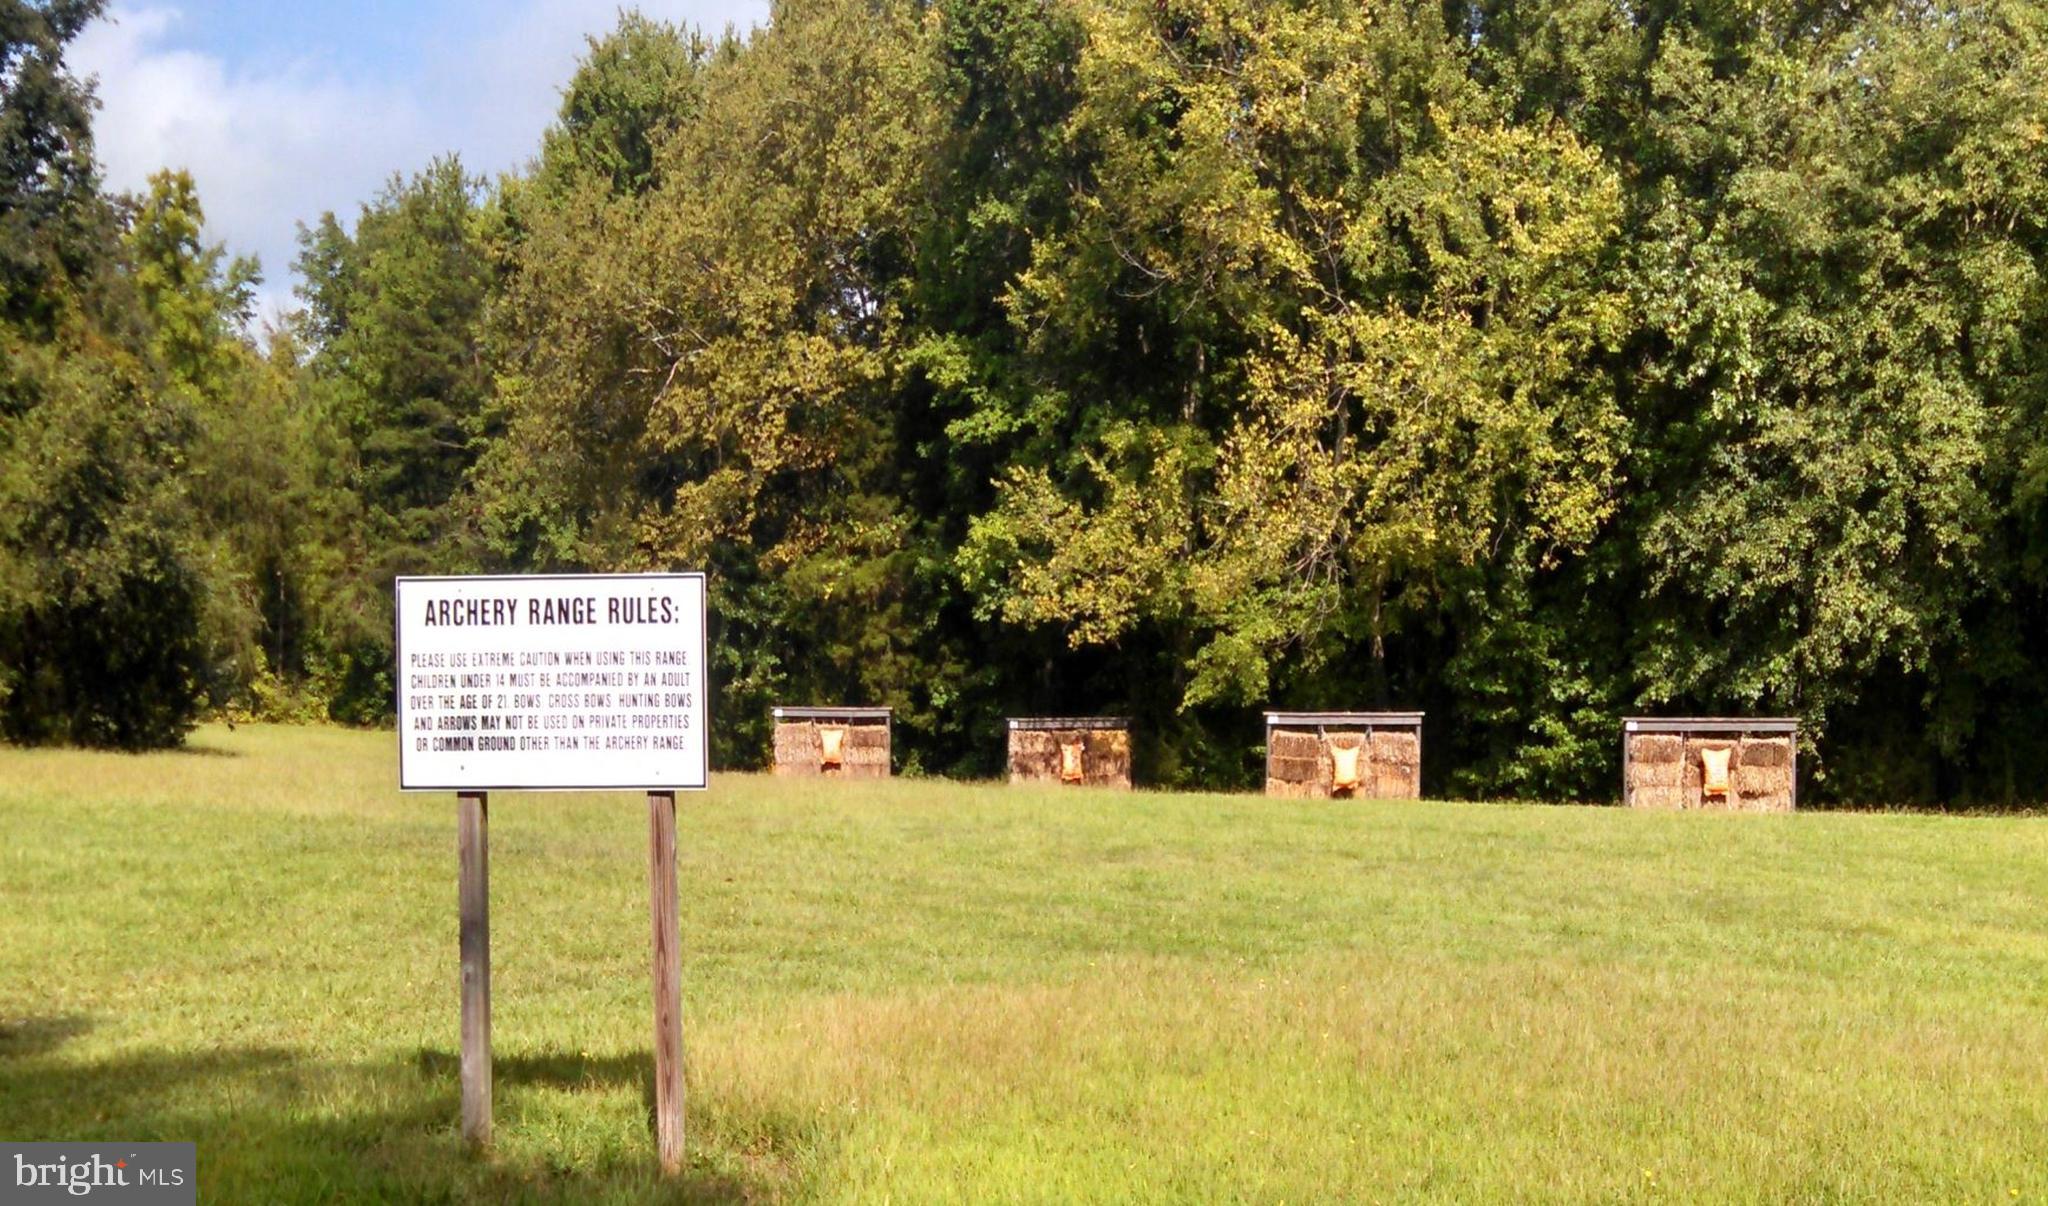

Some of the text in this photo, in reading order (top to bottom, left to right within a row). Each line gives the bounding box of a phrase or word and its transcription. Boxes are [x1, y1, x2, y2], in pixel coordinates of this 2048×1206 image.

[425, 596, 680, 626] ARCHERY RANGE RULES:
[411, 653, 445, 668] PLEASE
[450, 652, 467, 667] USE
[472, 652, 515, 667] EXTREME
[520, 652, 560, 667] CAUTION
[565, 651, 592, 666] WHEN
[597, 651, 625, 666] USING
[630, 651, 651, 666] THIS
[411, 672, 690, 689] CHILDREN UNDER 14 MUST BE ACCOMPANIED BY AN ADULT
[411, 695, 434, 710] OVER
[439, 695, 455, 710] THE
[460, 695, 478, 709] AGE
[482, 694, 494, 709] OF
[549, 693, 579, 708] CROSS
[619, 693, 660, 708] HUNTING
[665, 693, 692, 708] BOWS
[414, 714, 690, 731] AND ARROWS MAY NOT BE USED ON PRIVATE PROPERTIES
[416, 737, 428, 752] OR
[433, 737, 474, 752] COMMON
[478, 737, 516, 751] GROUND
[520, 736, 550, 751] OTHER
[554, 736, 579, 750] THAN
[584, 736, 600, 750] THE
[605, 736, 648, 750] ARCHERY
